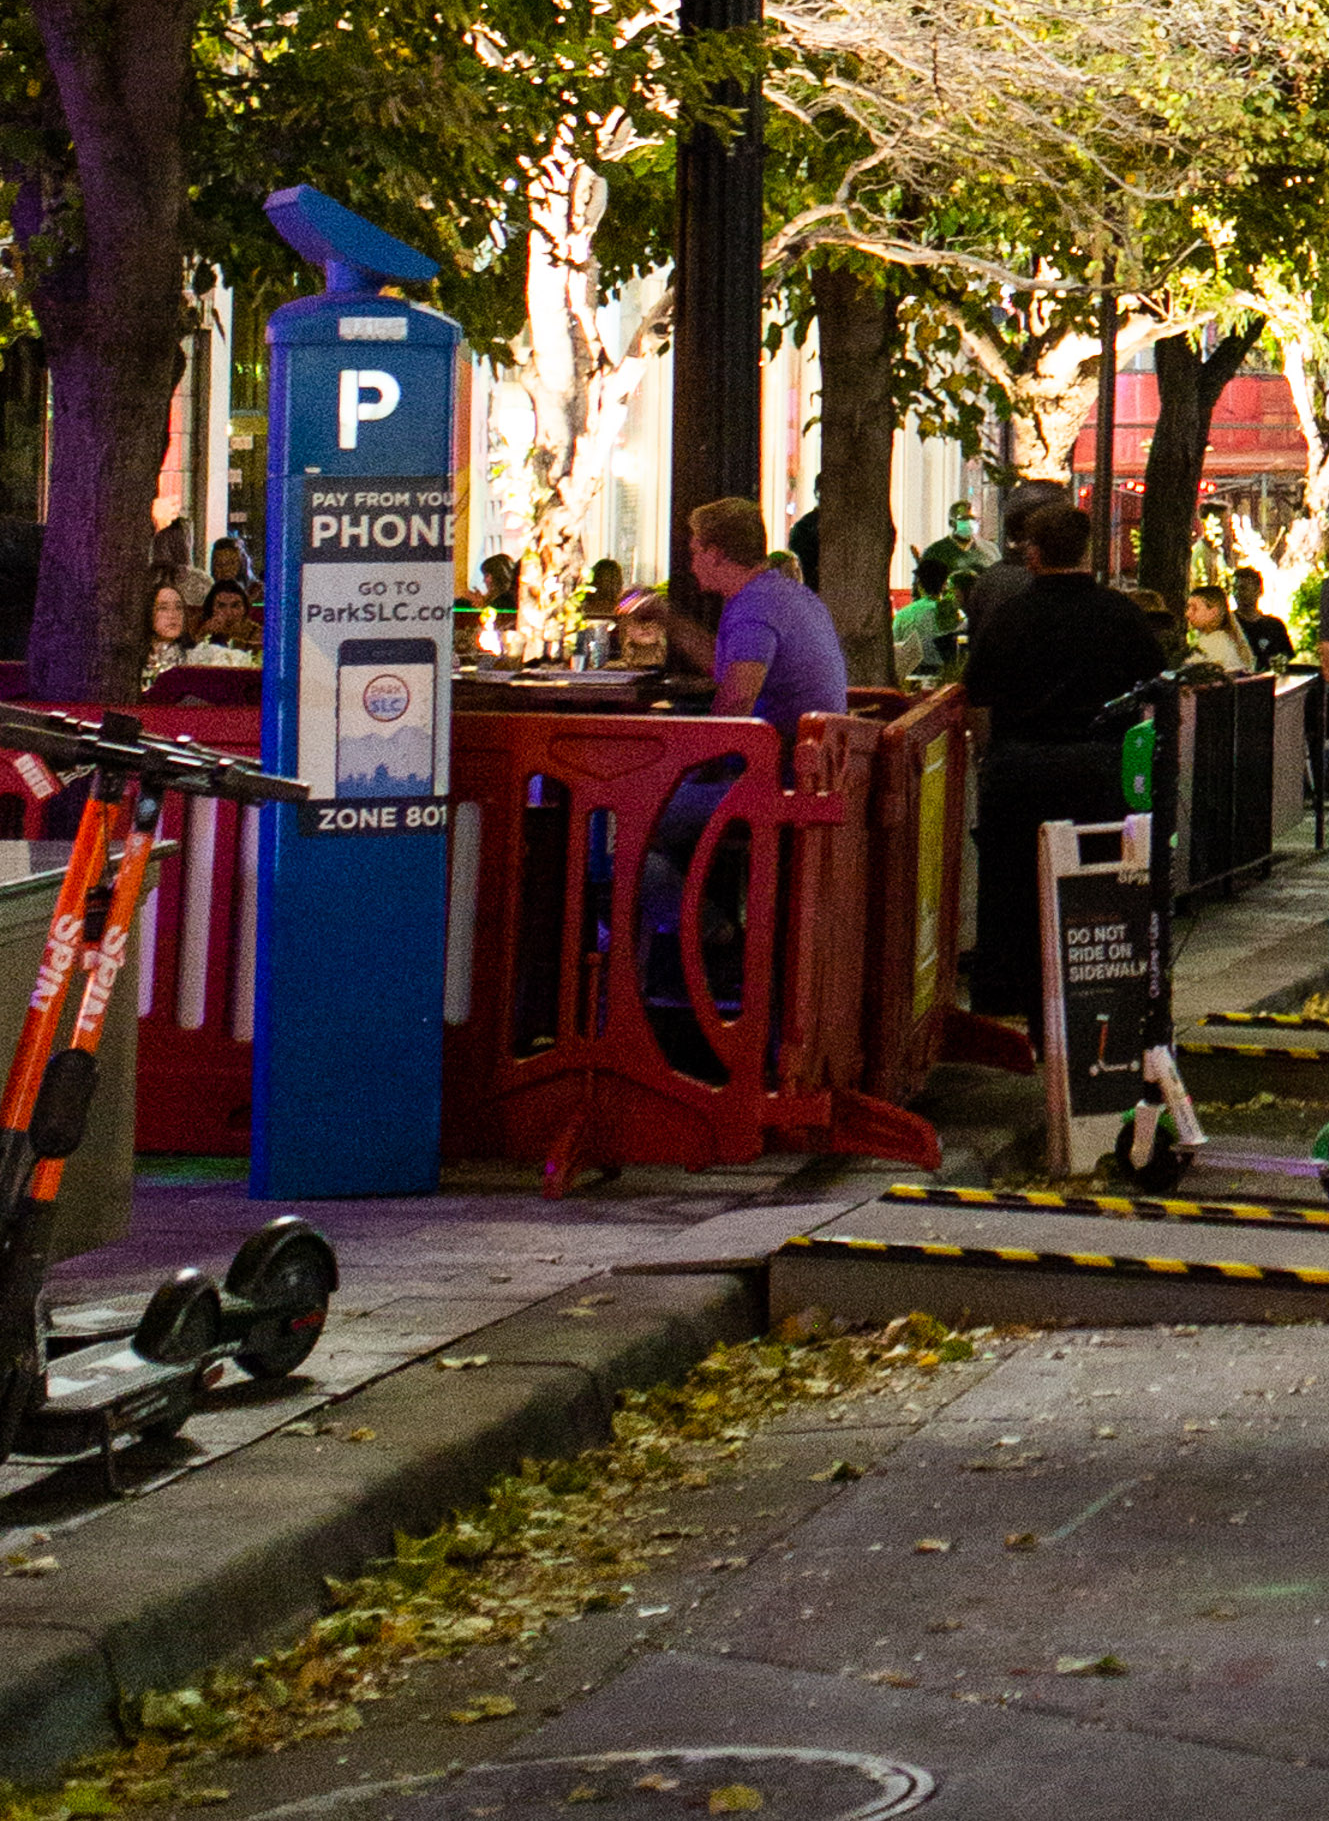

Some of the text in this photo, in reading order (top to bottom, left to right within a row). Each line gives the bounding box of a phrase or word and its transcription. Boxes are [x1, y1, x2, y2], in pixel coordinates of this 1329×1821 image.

[339, 369, 401, 450] P
[312, 491, 348, 508] PAY
[354, 491, 411, 508] FROM
[358, 580, 421, 596] GO TO
[369, 698, 403, 713] SLC
[318, 804, 448, 830] ZONE 801
[1067, 923, 1128, 946] DO NOT
[30, 914, 83, 1013] SPIN
[1067, 942, 1132, 964] RIDE ON
[80, 924, 129, 1033] SPIN
